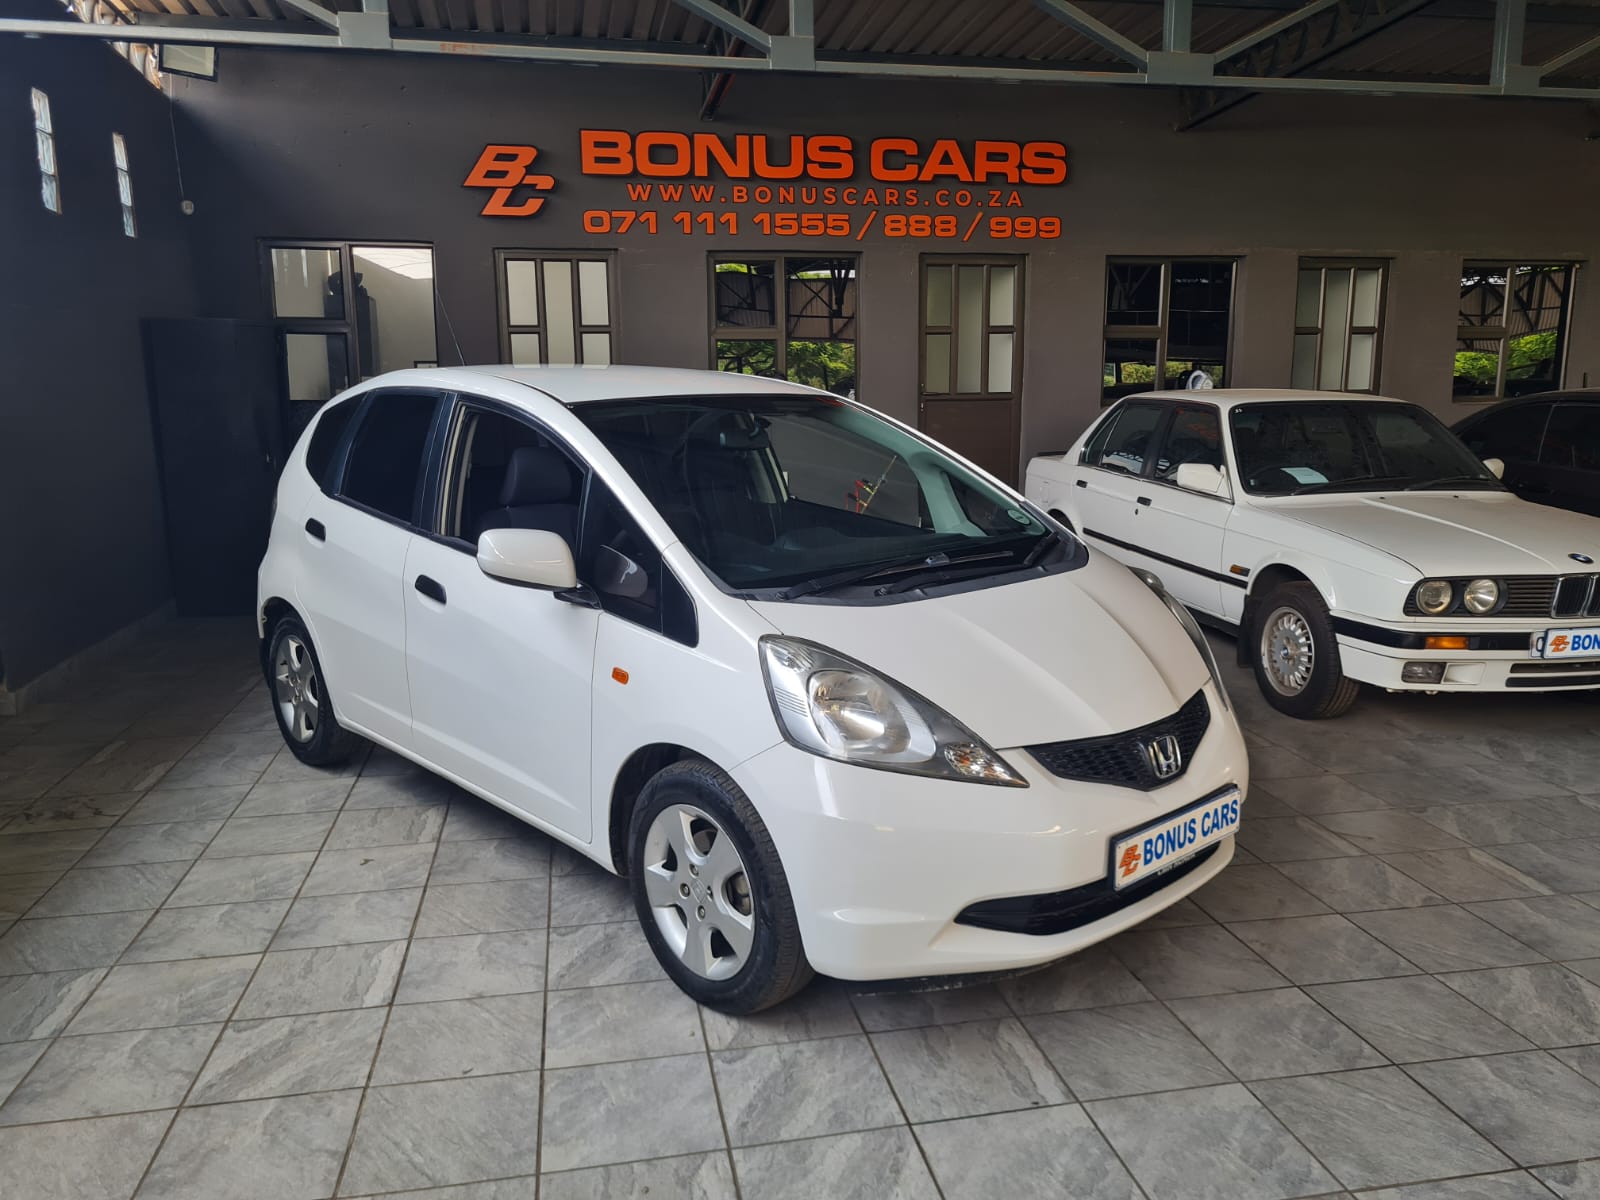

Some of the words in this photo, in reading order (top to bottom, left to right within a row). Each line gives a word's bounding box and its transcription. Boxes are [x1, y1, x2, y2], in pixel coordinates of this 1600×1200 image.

[580, 129, 854, 178] BONUS
[869, 138, 1067, 184] CARS
[627, 183, 1023, 208] WWW.BONUSCARS.CO.ZA
[583, 210, 658, 235] 071
[672, 211, 738, 235] 111
[1143, 818, 1196, 866] BONUS
[1201, 800, 1239, 838] CARS
